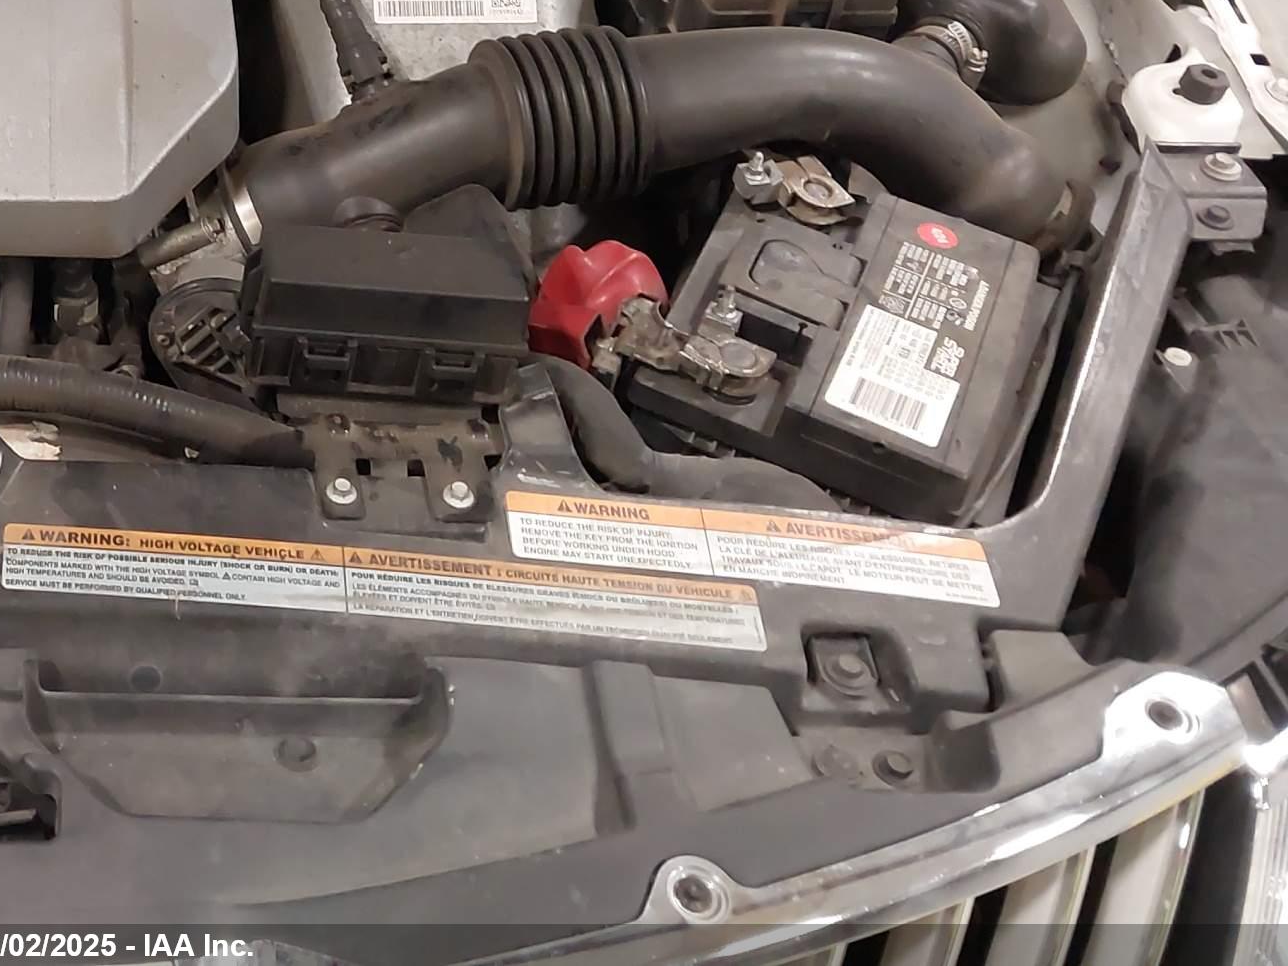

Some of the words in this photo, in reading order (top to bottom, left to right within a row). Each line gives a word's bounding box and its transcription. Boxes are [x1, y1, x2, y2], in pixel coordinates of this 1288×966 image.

[574, 502, 649, 520] WARNING
[520, 517, 532, 526] TO
[535, 519, 573, 529] REDUCE
[576, 523, 593, 531] THE
[597, 525, 619, 534] RISK
[622, 527, 634, 535] OF
[39, 529, 130, 547] WARNING:
[139, 537, 173, 550] HIGH
[177, 540, 240, 555] VOLTAGE
[244, 545, 304, 559] VEHICLE
[521, 527, 561, 538] REMOVE
[564, 531, 580, 540] THE
[584, 533, 602, 542] KEY
[605, 535, 633, 545] FROM
[636, 538, 653, 547] THE
[656, 540, 697, 551] IGNITION
[522, 536, 560, 547] BEFORE
[563, 540, 609, 552] WORKING
[612, 545, 644, 555] UNDER
[717, 534, 743, 545] POUR
[20, 548, 52, 556] REDUCE
[55, 550, 71, 558] THE
[108, 554, 147, 563] POSSIBLE
[149, 557, 185, 566] SERIOUS
[187, 559, 217, 568] INJURY
[219, 562, 250, 570] (SHOCK
[267, 565, 293, 573] BURN)
[523, 545, 559, 556] ENGINE
[562, 549, 582, 558] MAY
[584, 551, 613, 561] START
[6, 557, 58, 568] COMPONENTS
[61, 561, 93, 570] MARKED
[131, 566, 150, 574] HIGH
[152, 568, 186, 576] VOLTAGE
[188, 570, 219, 578] SYMBOL
[232, 573, 265, 582] CONTAIN
[267, 576, 285, 584] HIGH
[287, 577, 322, 586] VOLTAGE
[324, 580, 340, 588] AND
[6, 566, 24, 574] HIGH
[27, 568, 86, 578] TEMPERATURES
[88, 572, 104, 580] AND
[106, 573, 137, 582] SHOULD
[139, 575, 149, 583] BE
[351, 570, 374, 579] POUR
[376, 573, 412, 583] RÉDUIRE
[415, 576, 431, 585] LES
[433, 578, 471, 589] RISQUES
[473, 582, 483, 590] DE
[485, 583, 534, 594] BLESSURES
[369, 554, 491, 576] AVERTISSEMENT
[505, 567, 558, 582] CIRCUITS
[562, 573, 598, 586] HAUTE
[604, 577, 652, 591] TENSION
[657, 582, 672, 593] DU
[5, 578, 37, 586] SERVICE
[39, 580, 60, 588] MUST
[62, 581, 72, 589] BE
[74, 582, 121, 592] PERFORMED
[135, 586, 176, 596] QUALIFIED
[178, 589, 223, 599] PERSONNEL
[352, 582, 366, 590] LES
